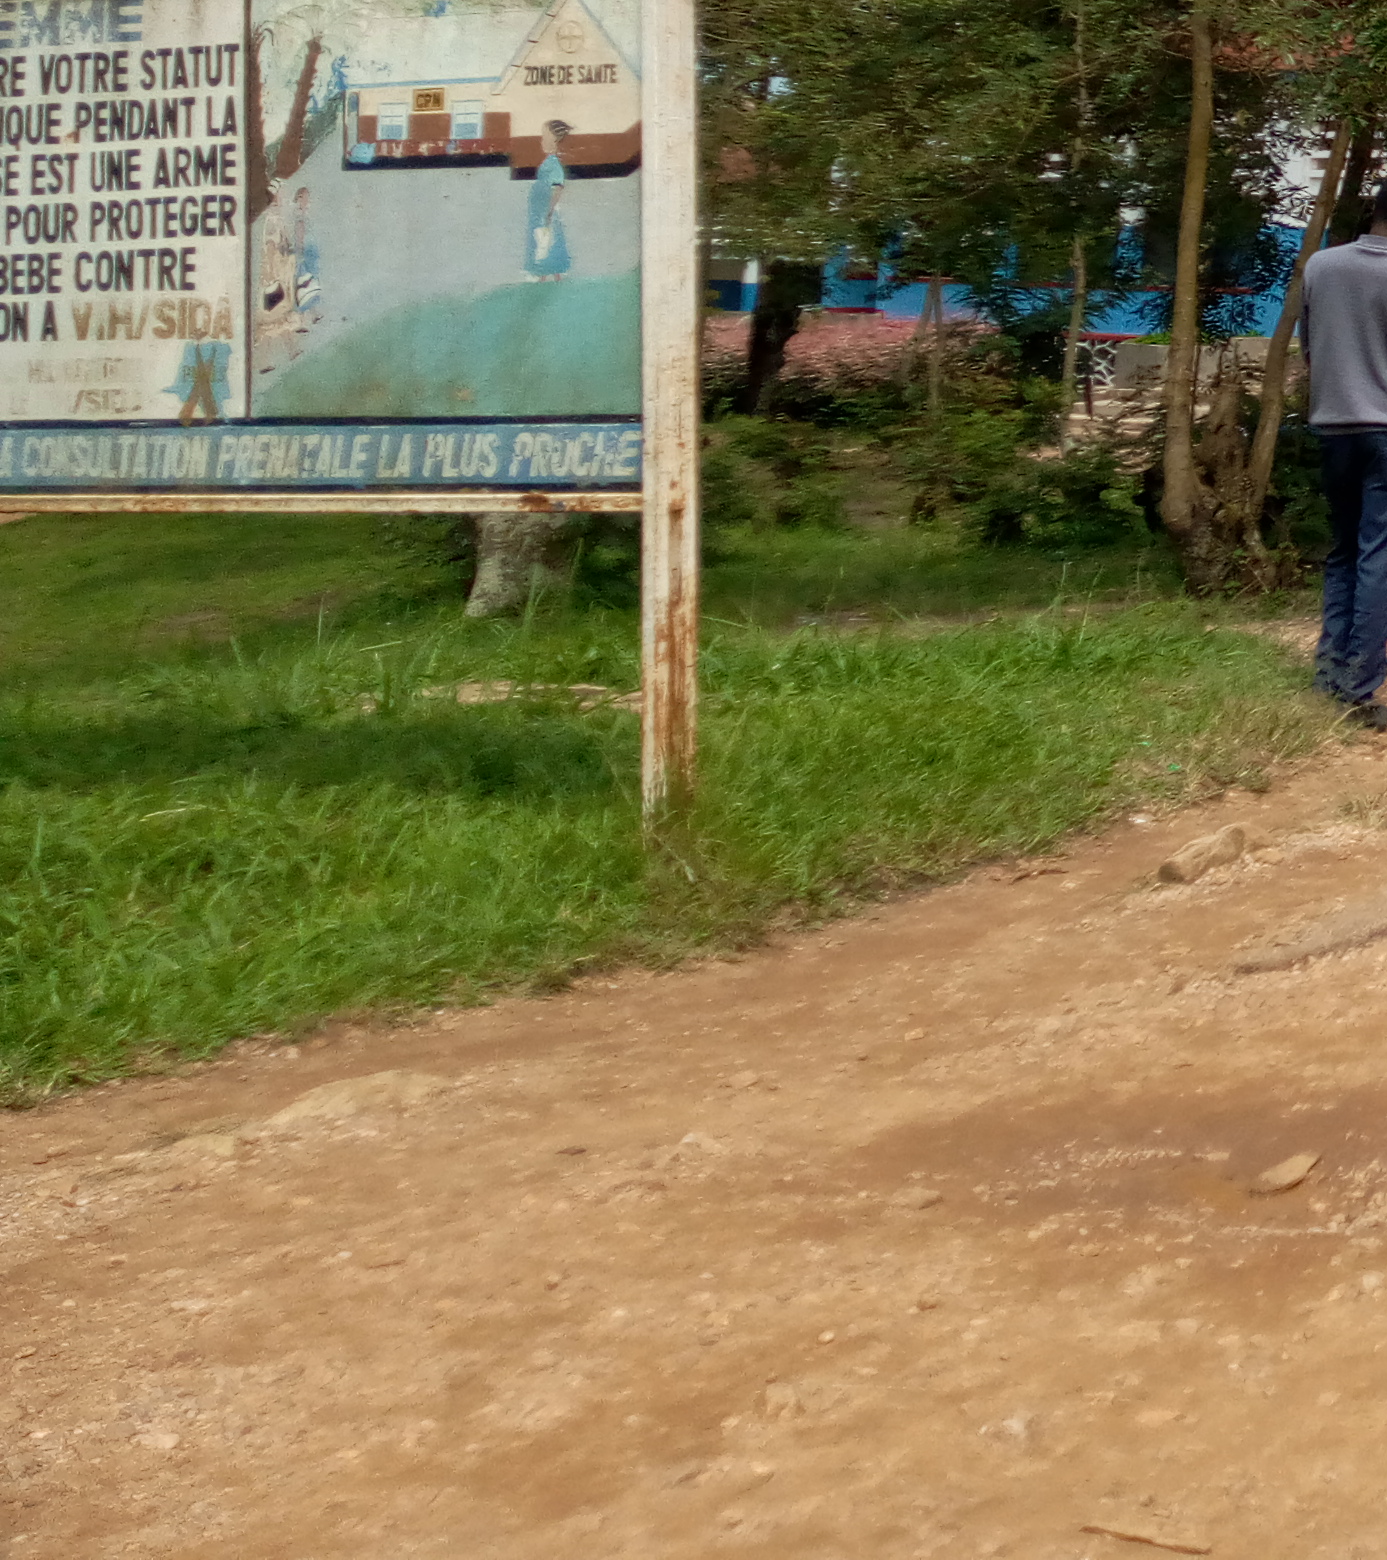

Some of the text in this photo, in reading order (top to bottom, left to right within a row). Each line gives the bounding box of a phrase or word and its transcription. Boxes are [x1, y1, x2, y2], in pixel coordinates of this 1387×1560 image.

[39, 50, 129, 95] VOTRE
[140, 43, 240, 90] STATUT
[523, 63, 618, 86] ZONE DE SANTE
[75, 97, 196, 143] PENDANT
[206, 96, 238, 136] LA
[0, 143, 236, 196] E EST UNE ARME
[6, 195, 237, 245] POUR PROTEGER
[74, 247, 196, 293] CONTRE
[41, 301, 58, 341] A
[376, 435, 412, 477] LA
[422, 433, 499, 477] PLUS
